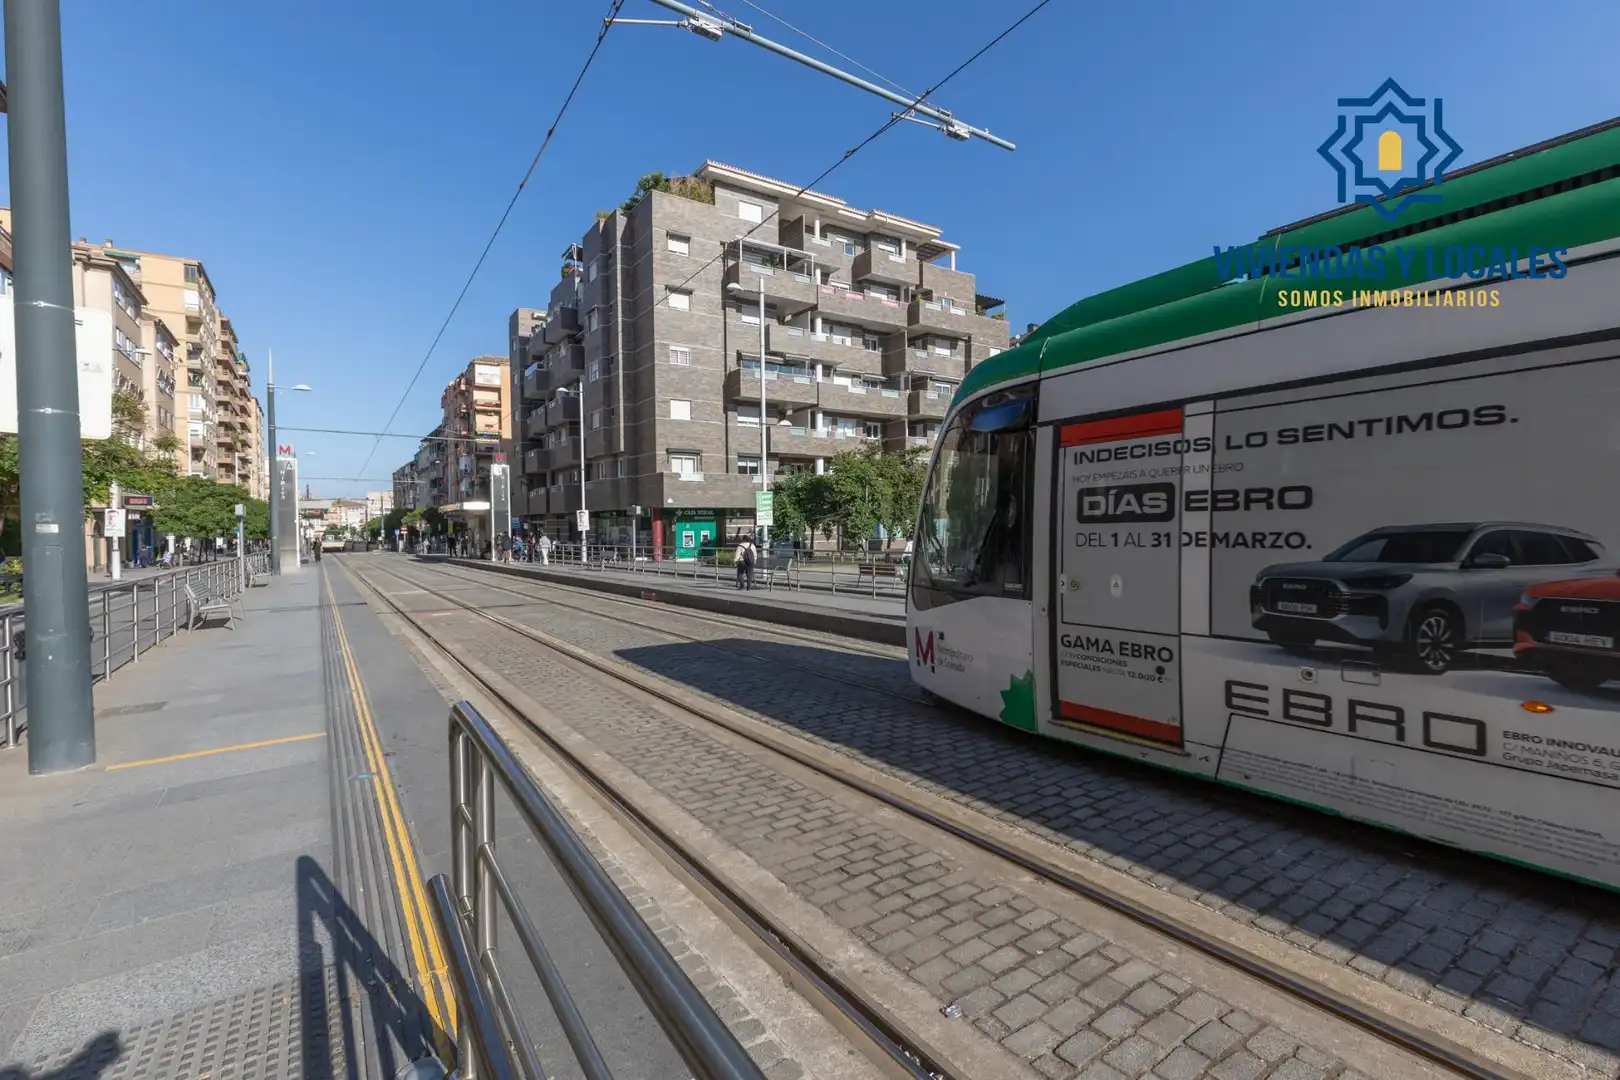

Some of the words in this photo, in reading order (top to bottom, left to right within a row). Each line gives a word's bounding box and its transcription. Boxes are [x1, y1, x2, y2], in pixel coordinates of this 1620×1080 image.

[1225, 431, 1268, 450] LO
[1276, 404, 1520, 446] SENTIMOS.
[1139, 469, 1148, 479] A
[1193, 464, 1209, 474] UN
[1083, 489, 1169, 516] DÍAS
[1184, 485, 1313, 512] EBRO
[1075, 532, 1107, 548] DEL
[1111, 532, 1119, 547] 1
[1123, 532, 1146, 547] AL
[1150, 532, 1172, 548] 31
[1179, 531, 1208, 548] DE
[1211, 531, 1313, 550] MARZO.
[1060, 633, 1115, 655] GAMA
[1119, 641, 1174, 663] EBRO
[1224, 679, 1487, 757] EBRO
[1502, 730, 1543, 744] EBRO
